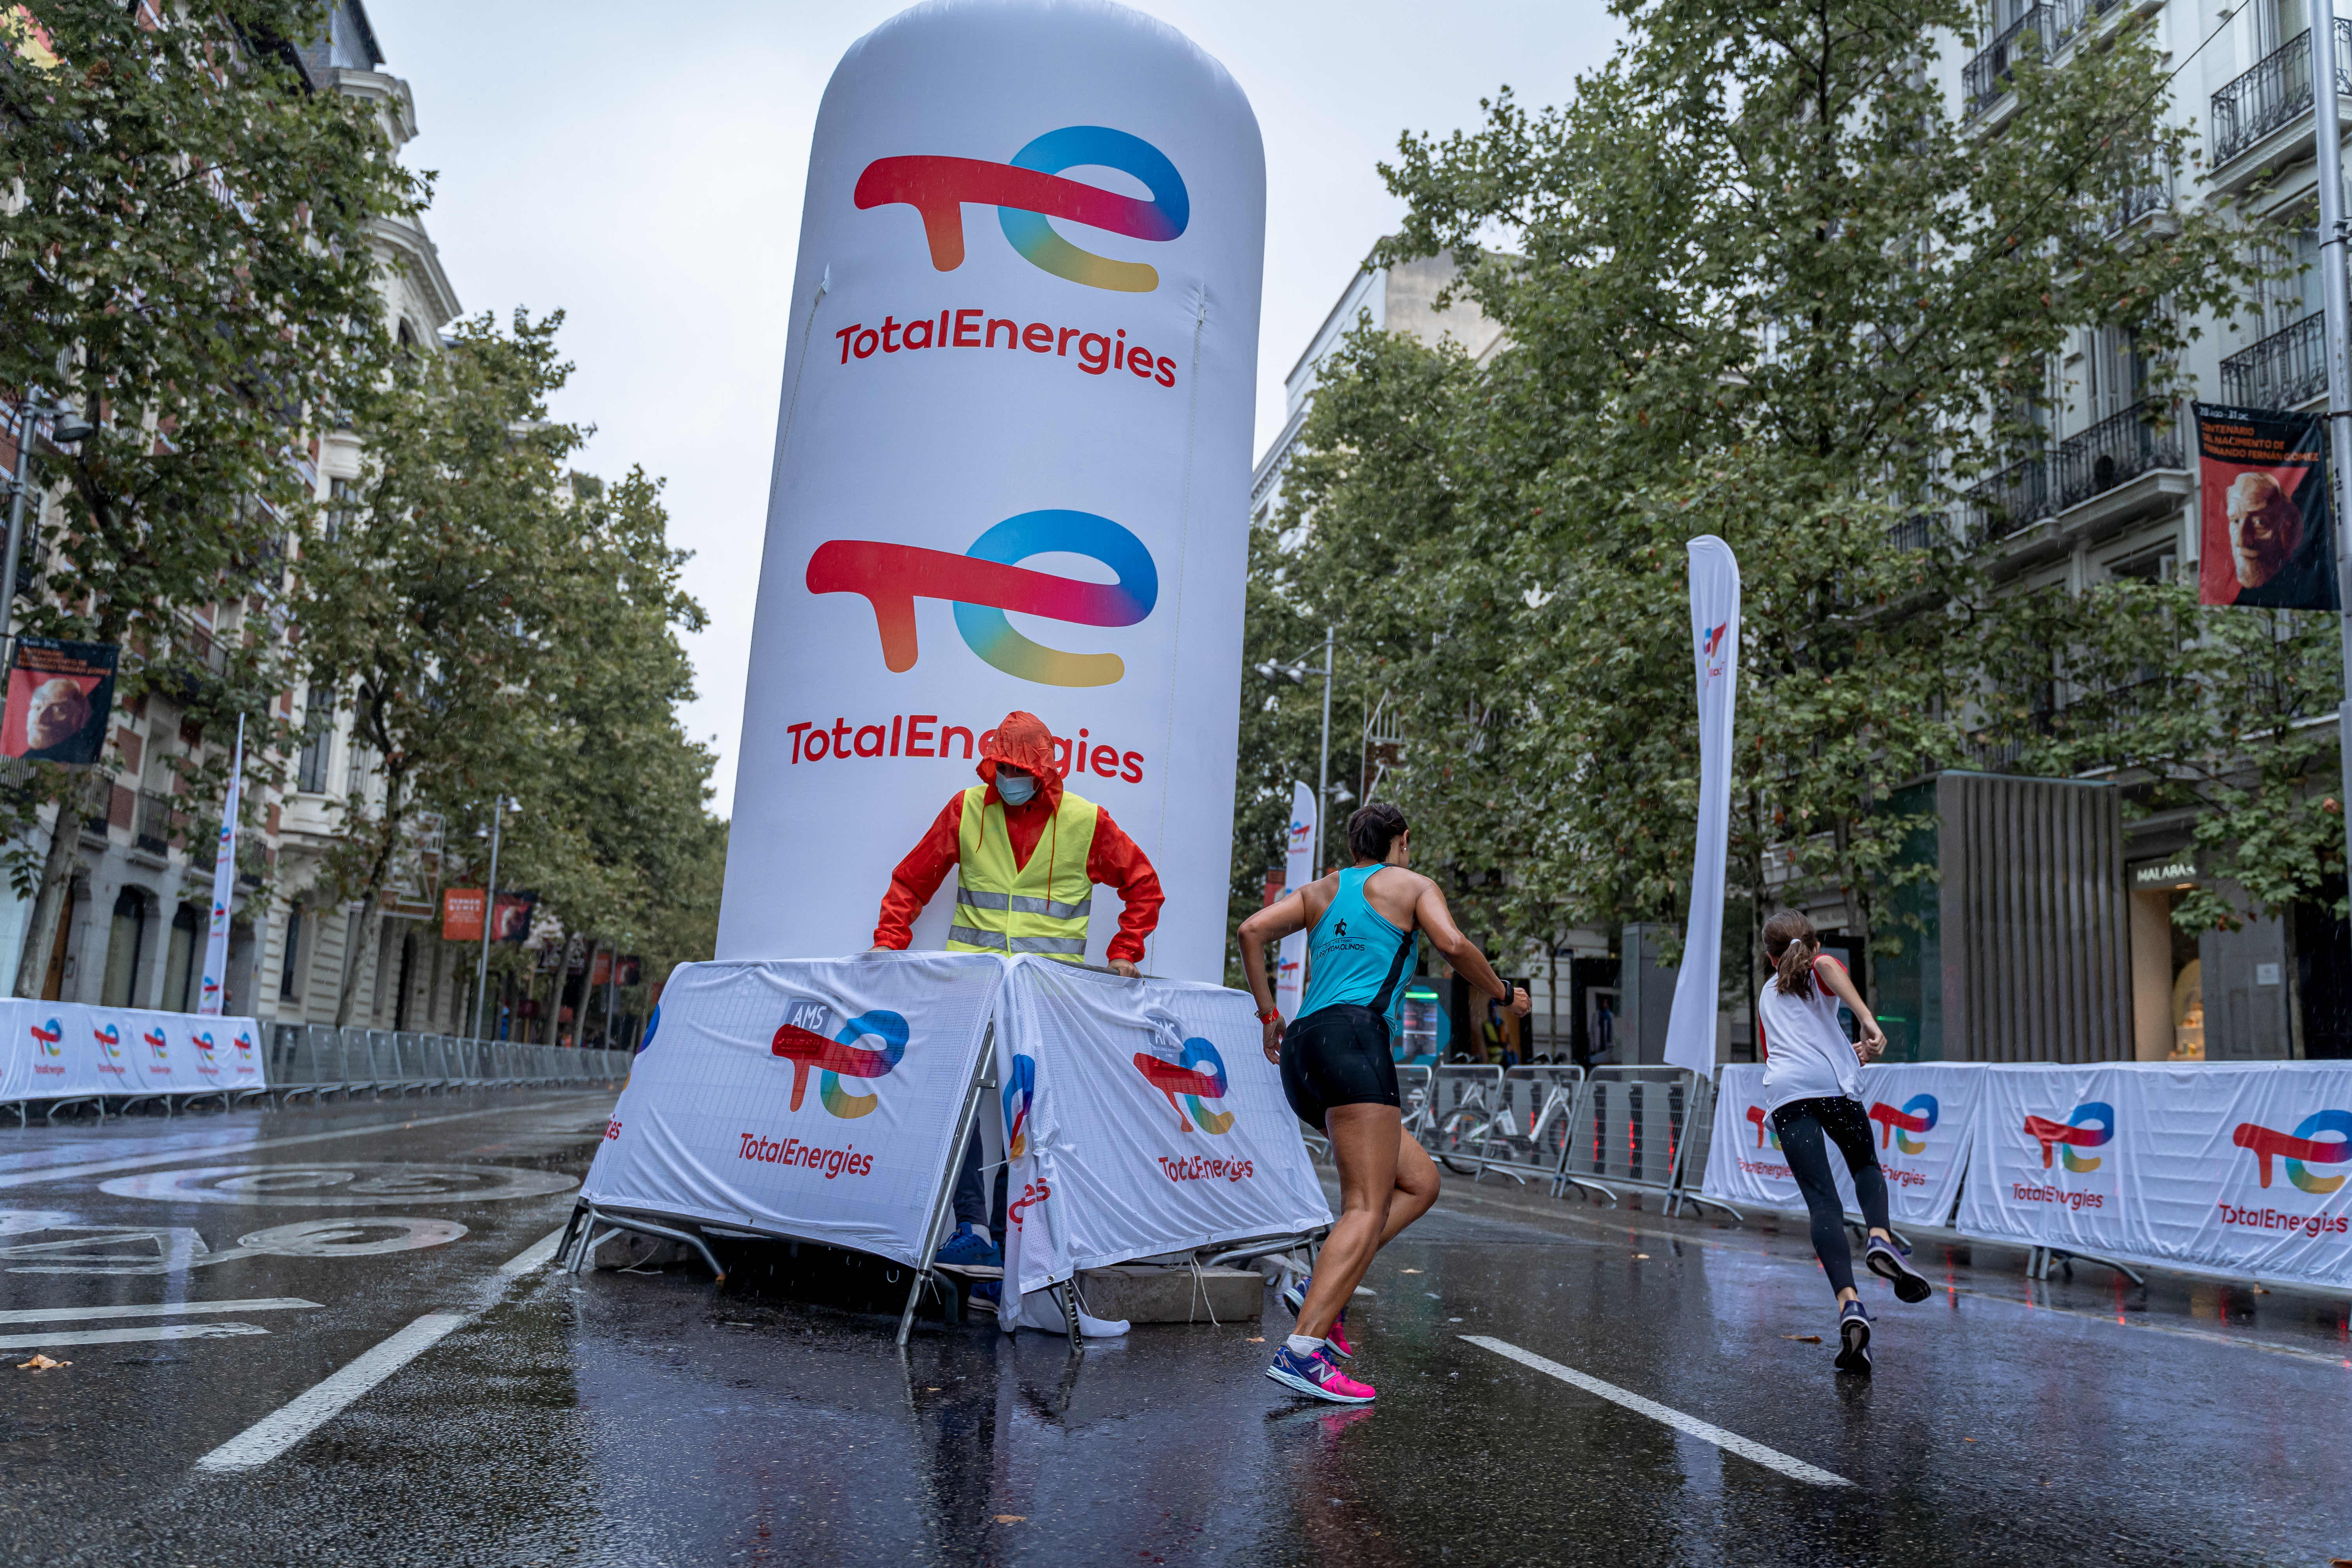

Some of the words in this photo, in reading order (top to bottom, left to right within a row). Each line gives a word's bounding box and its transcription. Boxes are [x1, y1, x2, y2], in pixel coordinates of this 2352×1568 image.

[836, 309, 1176, 387] TotalEnergies
[2274, 440, 2285, 450] DE
[786, 715, 1144, 784] TotalEngies
[2137, 863, 2197, 882] MALABA
[790, 1004, 828, 1029] AMS
[739, 1133, 873, 1179] TotalEnergies
[2219, 1204, 2348, 1238] TotalEnergies
